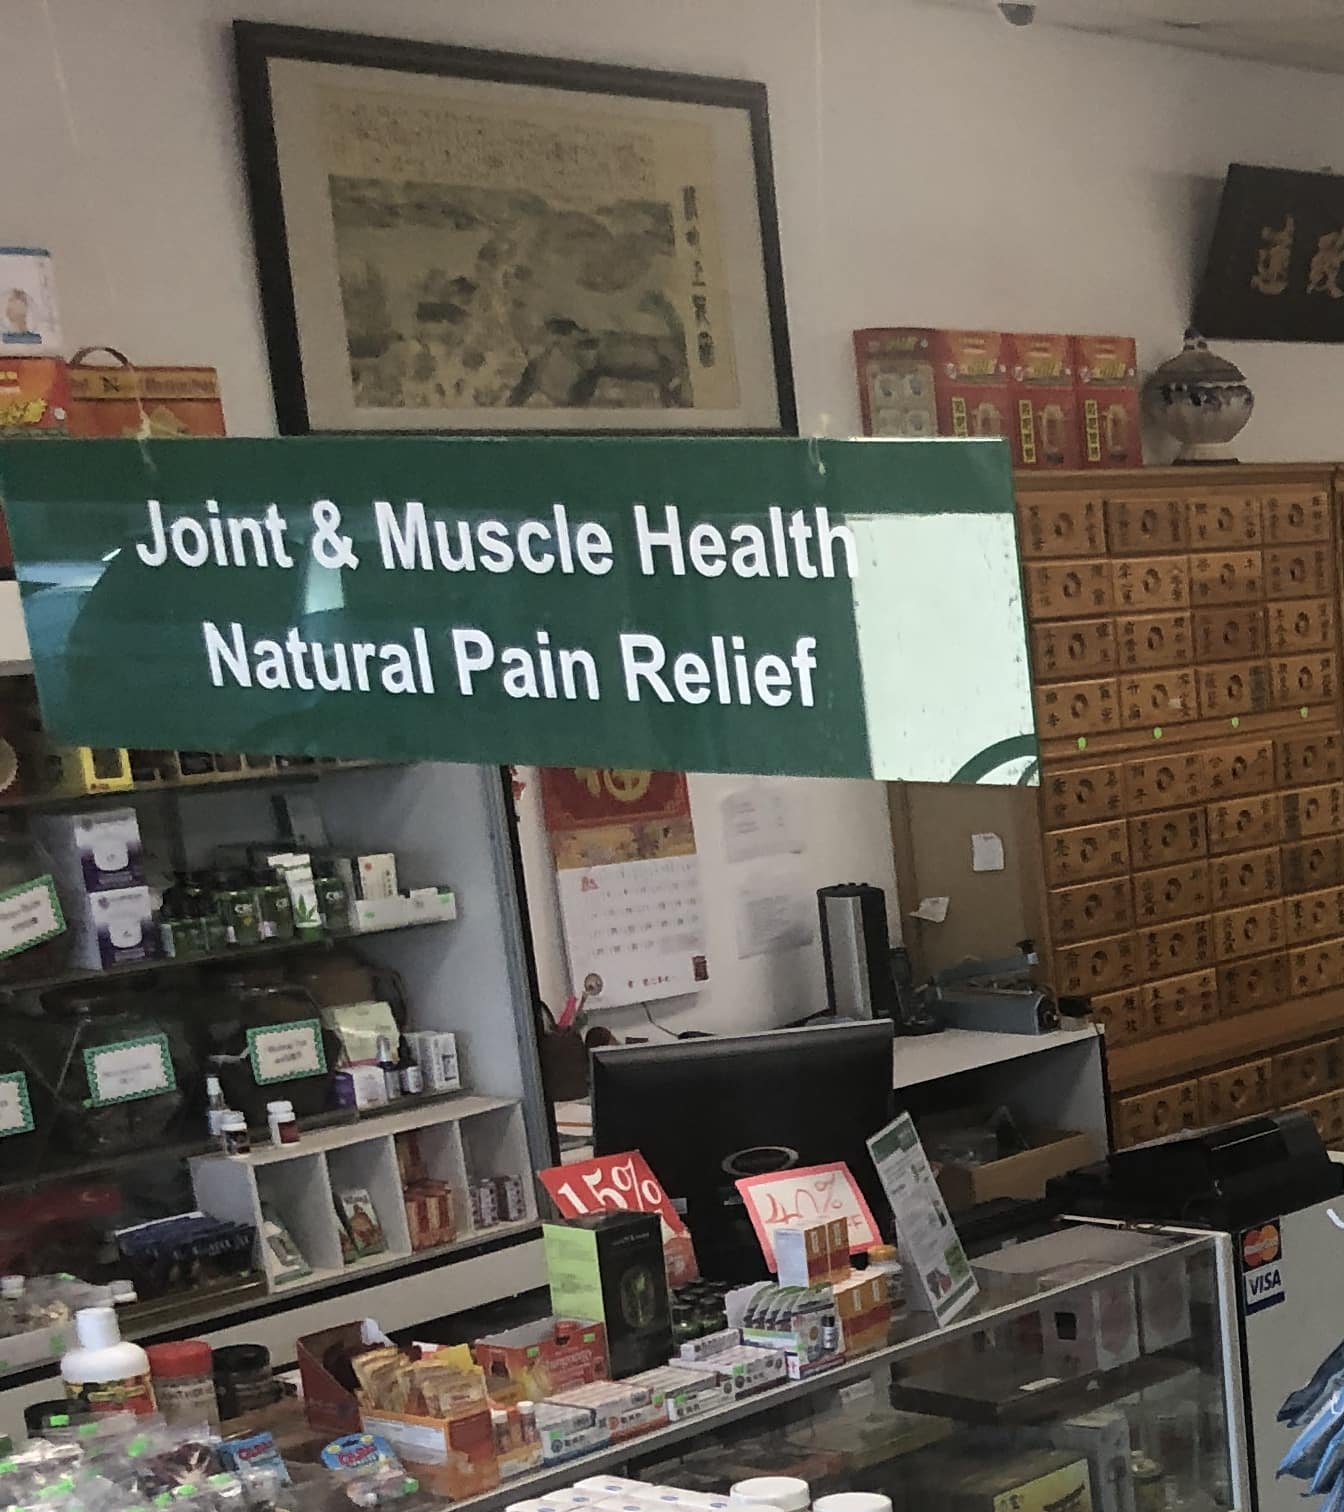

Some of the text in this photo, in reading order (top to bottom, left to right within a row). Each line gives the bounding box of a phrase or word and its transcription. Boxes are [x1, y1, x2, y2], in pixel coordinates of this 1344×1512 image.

[136, 500, 859, 580] Joint & Muscle Health
[202, 623, 815, 707] Natural Pain Relief
[1249, 1269, 1281, 1295] VISA
